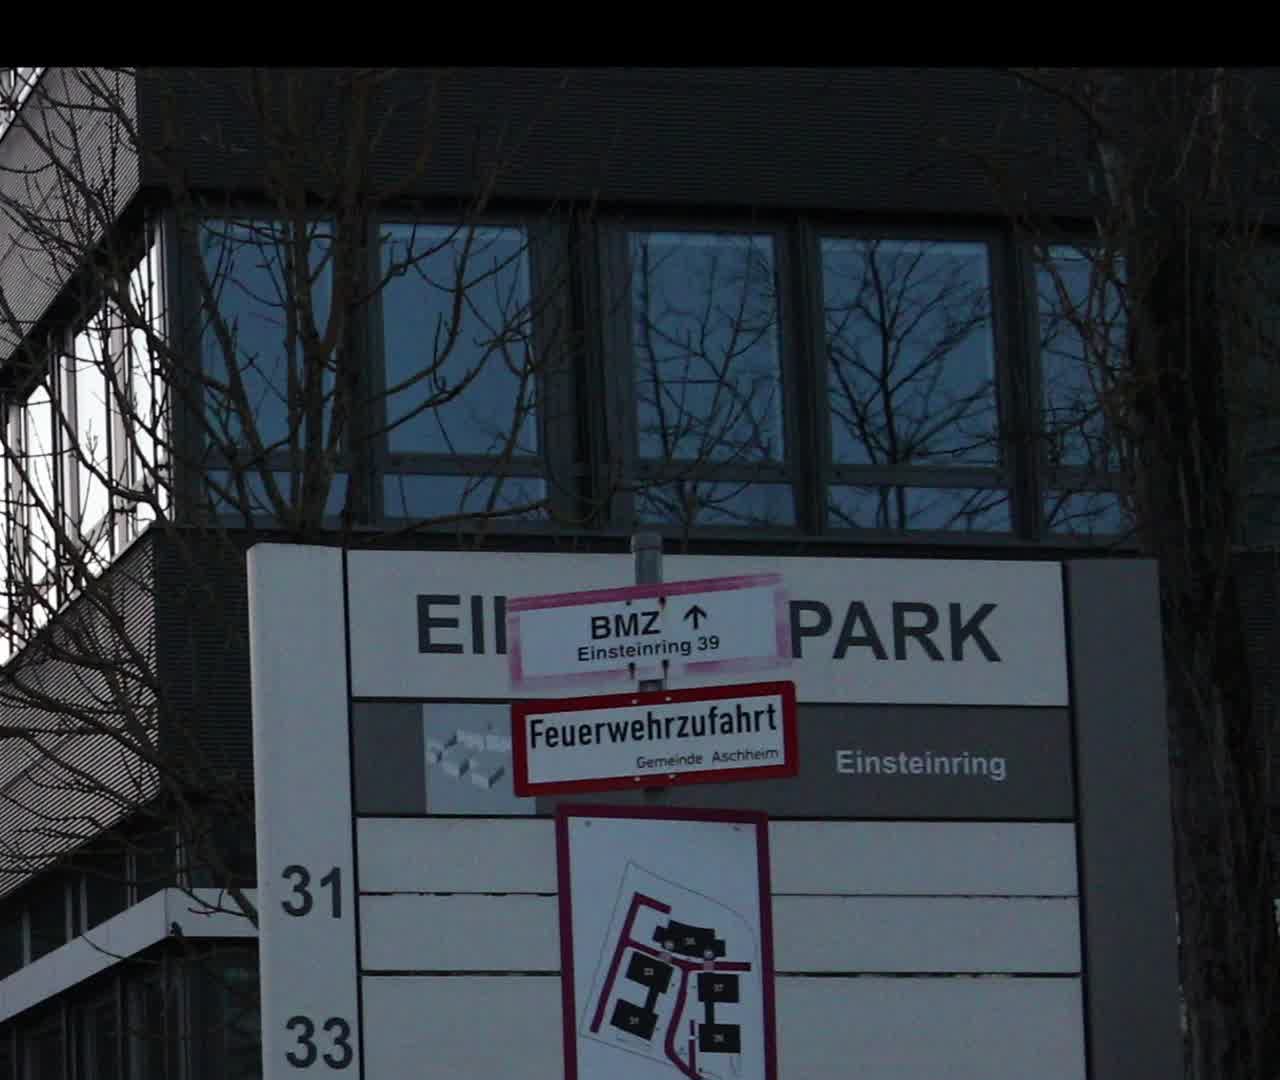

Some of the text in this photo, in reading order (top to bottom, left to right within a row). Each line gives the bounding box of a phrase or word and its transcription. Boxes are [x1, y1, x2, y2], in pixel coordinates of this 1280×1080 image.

[590, 611, 660, 640] BMZ
[789, 600, 1002, 662] PARK
[577, 635, 720, 662] Einsteinring 39
[530, 704, 777, 749] Feuerwehrzufahrt
[636, 747, 779, 769] Gemeinde Aschheim
[836, 749, 1007, 781] Einsteinring
[281, 864, 342, 919] 31
[286, 1015, 353, 1070] 33
